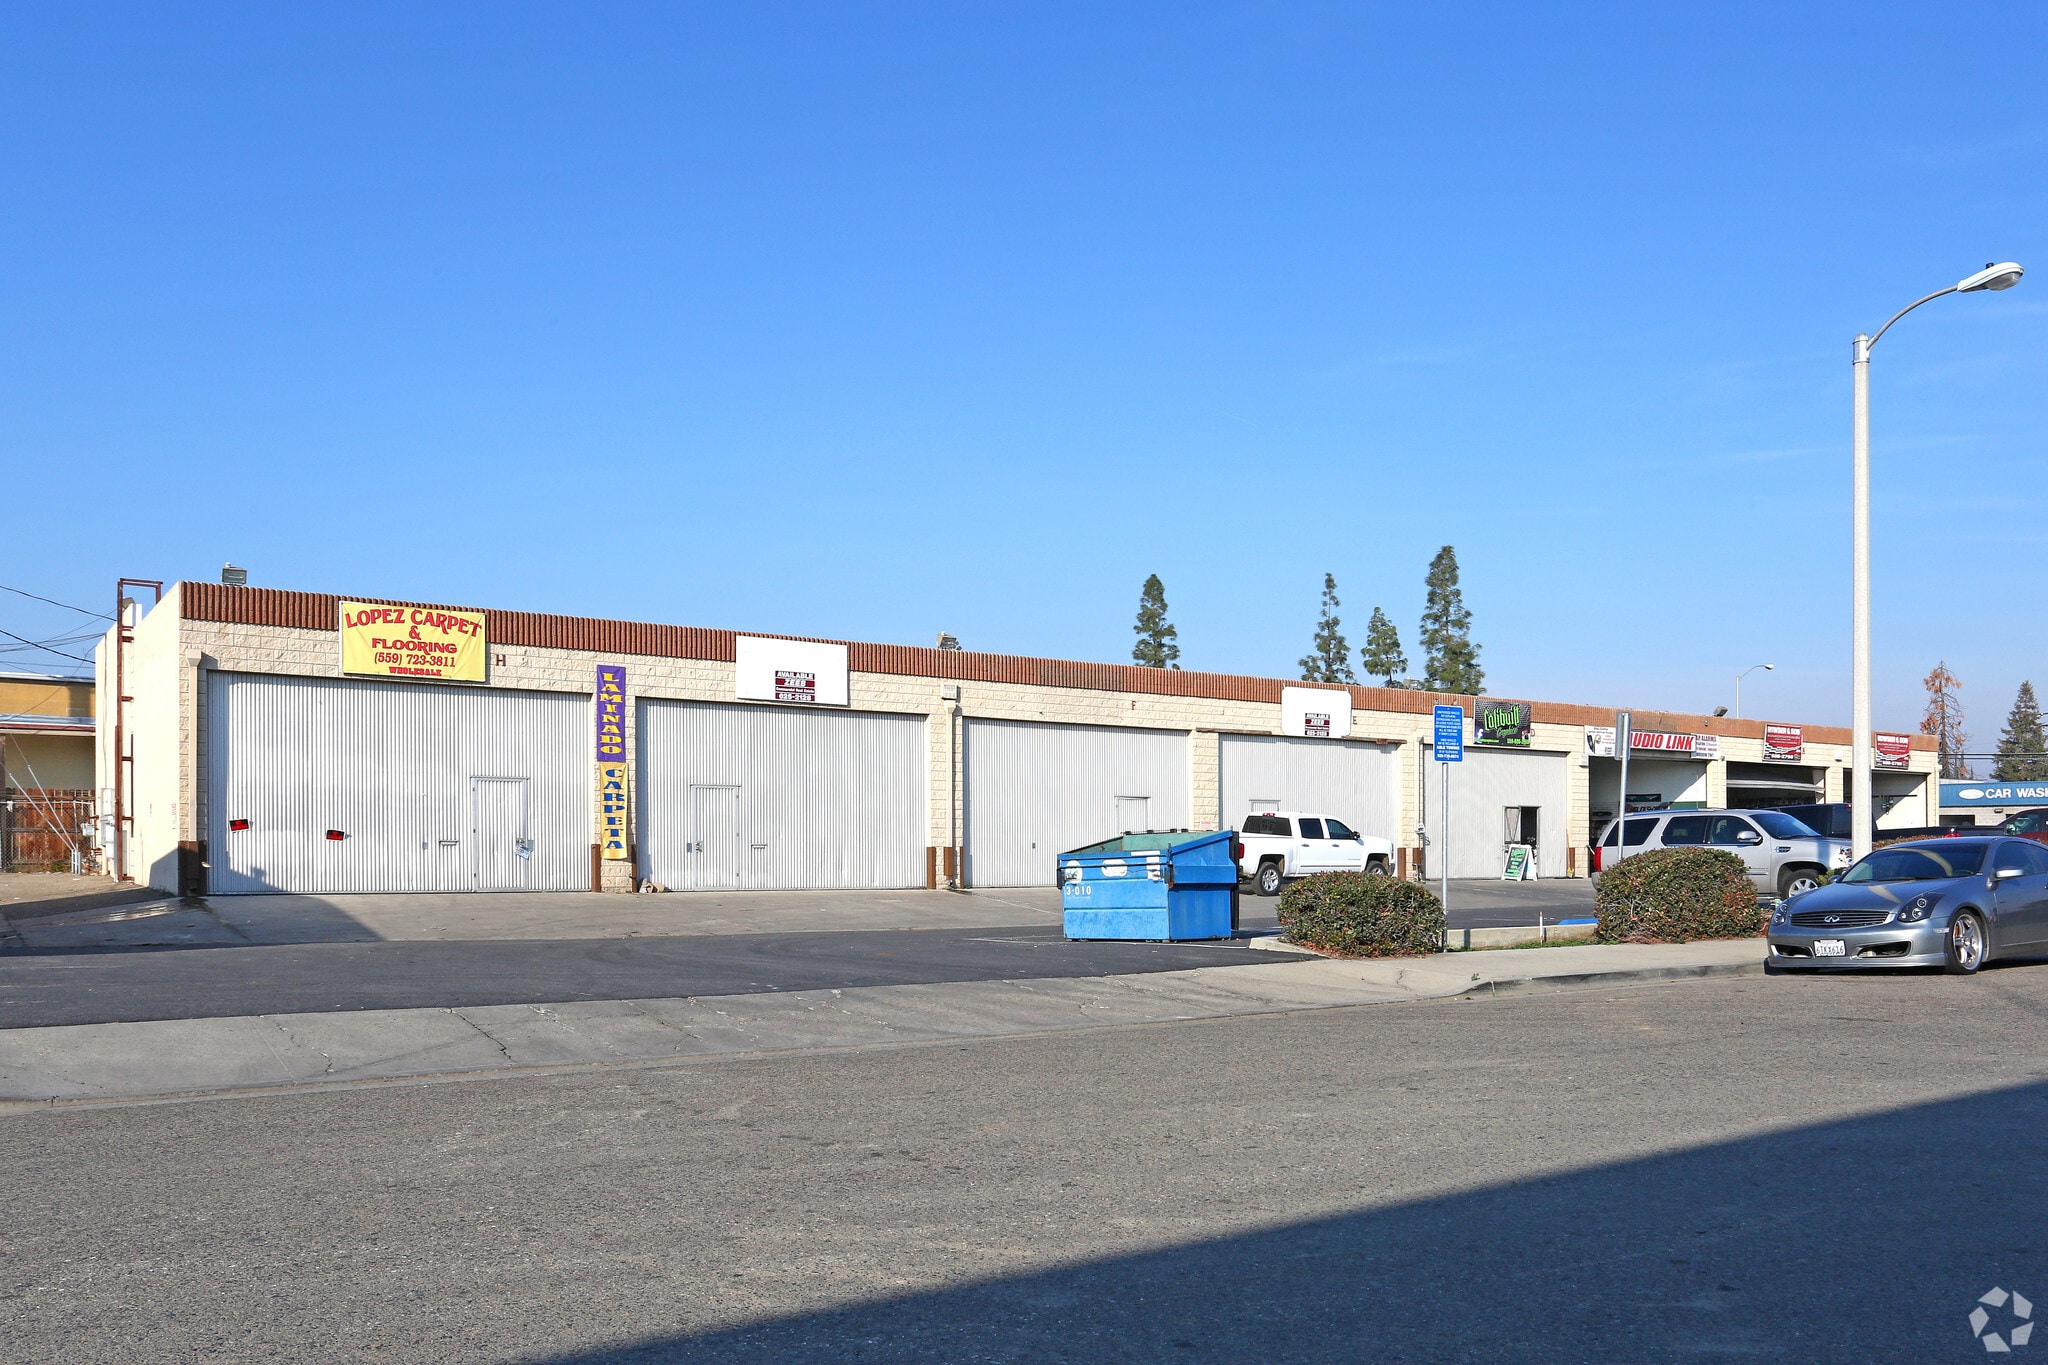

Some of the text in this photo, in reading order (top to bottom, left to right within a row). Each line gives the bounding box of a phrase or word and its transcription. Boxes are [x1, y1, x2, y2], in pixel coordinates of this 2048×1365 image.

[344, 609, 482, 638] LOPEZ CARPET
[409, 625, 422, 640] &
[372, 638, 458, 655] FLOORING
[374, 652, 456, 668] (559) 723-3811
[495, 654, 507, 667] H
[388, 666, 442, 677] WHOLESALE
[777, 671, 813, 679] AVAILABLE
[599, 672, 623, 755] LAMINADO
[1666, 734, 1694, 751] LINK
[1985, 788, 2012, 799] CAR
[603, 769, 625, 849] CARPETA
[1066, 886, 1091, 895] 3-010
